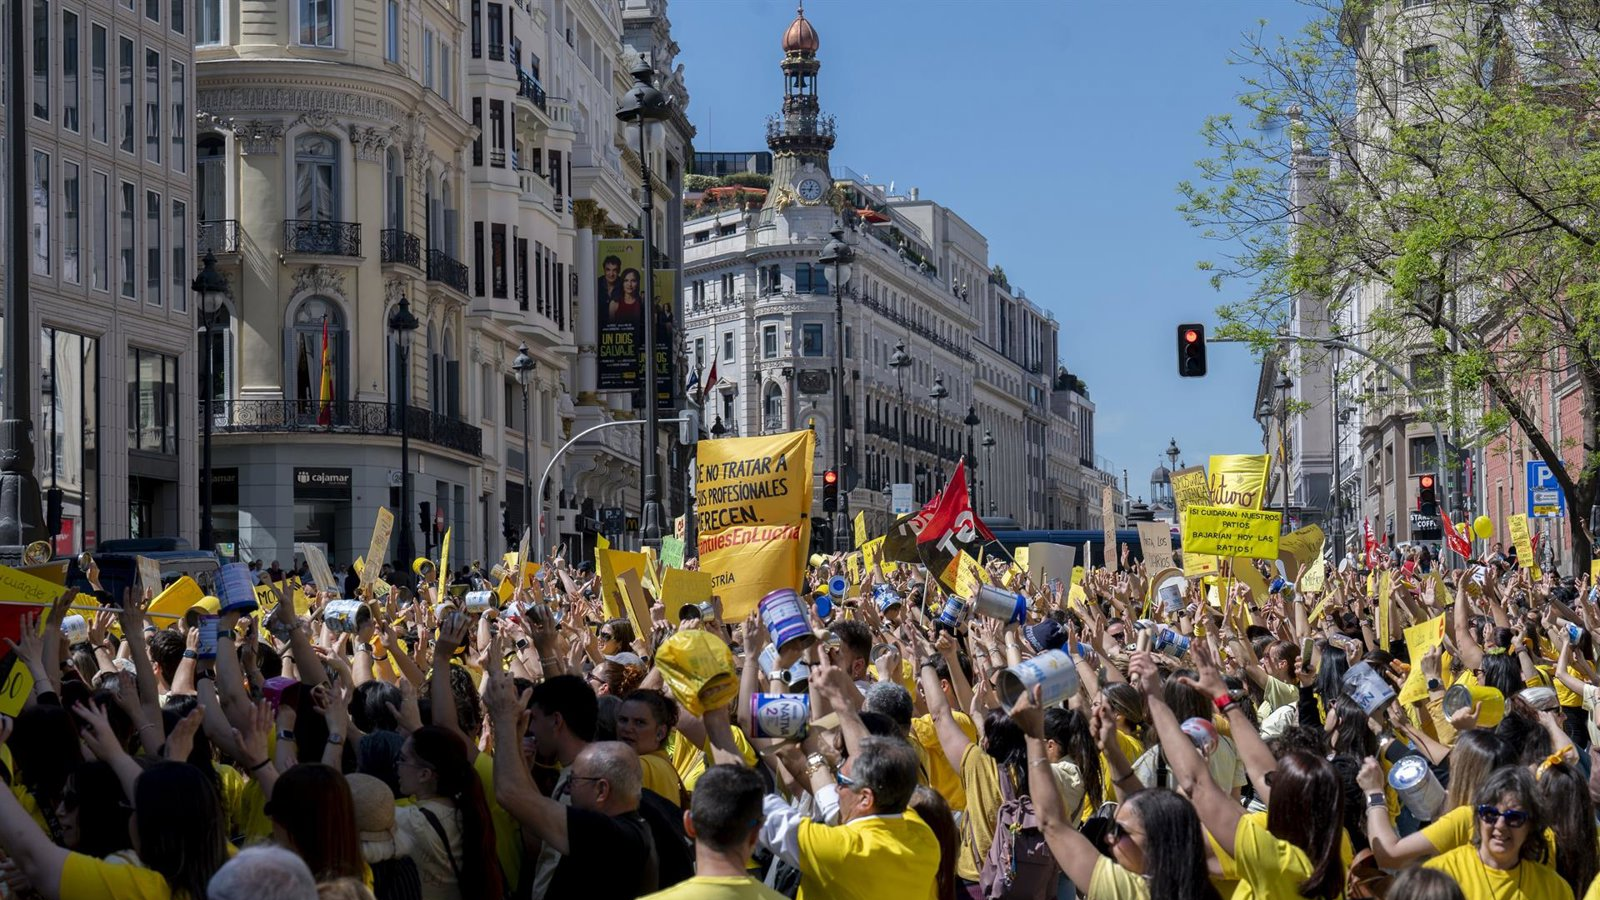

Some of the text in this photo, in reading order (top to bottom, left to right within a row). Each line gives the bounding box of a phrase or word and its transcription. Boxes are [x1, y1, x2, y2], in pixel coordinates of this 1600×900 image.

[602, 332, 633, 345] UN DIOS
[601, 344, 635, 357] SALVAJE
[706, 464, 719, 482] NO
[722, 457, 772, 480] TRATAR
[775, 453, 788, 473] A
[311, 473, 350, 484] cajamar
[1537, 466, 1553, 487] P
[1201, 509, 1237, 518] CUIDARAN
[1241, 512, 1280, 521] NUESTROS
[1222, 521, 1250, 529] PATIOS
[1237, 533, 1254, 541] HOY
[1257, 535, 1274, 543] LAS
[1216, 545, 1254, 553] RATIOS!
[766, 707, 778, 716] 2
